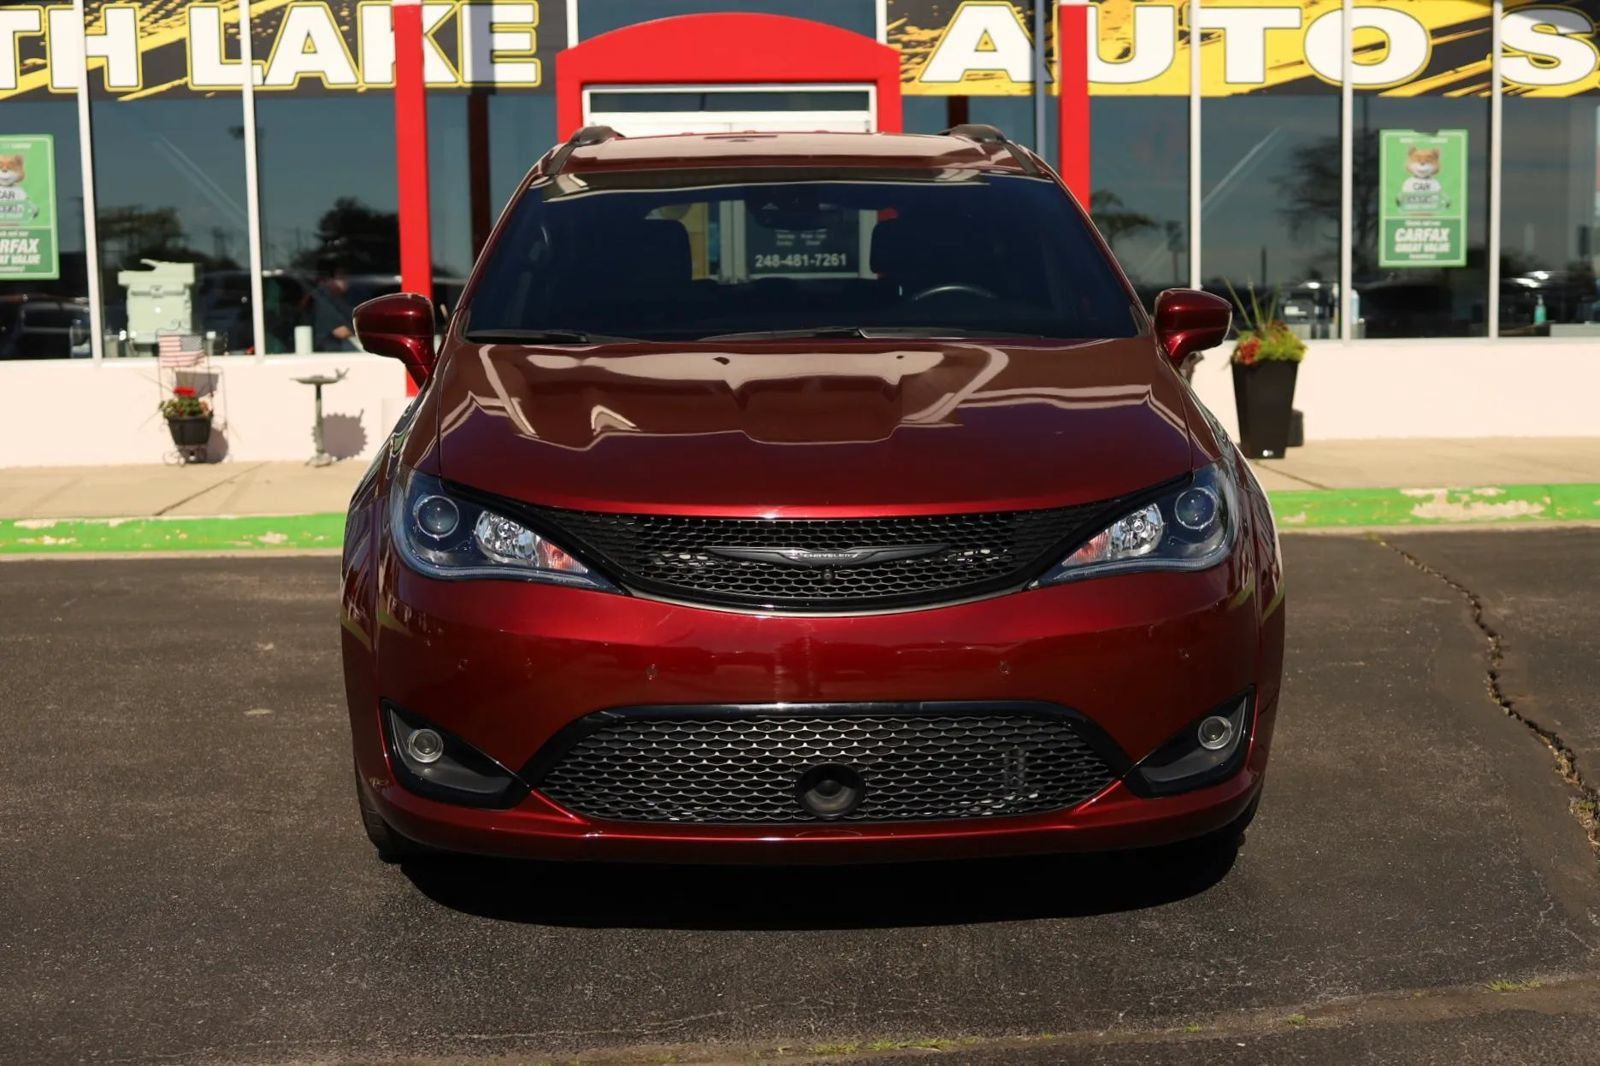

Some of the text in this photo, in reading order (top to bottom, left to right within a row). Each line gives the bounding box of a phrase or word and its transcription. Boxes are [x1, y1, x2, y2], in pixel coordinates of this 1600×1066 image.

[187, 2, 538, 88] LAKE
[919, 4, 1430, 87] AUTO
[1395, 228, 1450, 242] CARFAX
[754, 253, 847, 268] 248-481-7261
